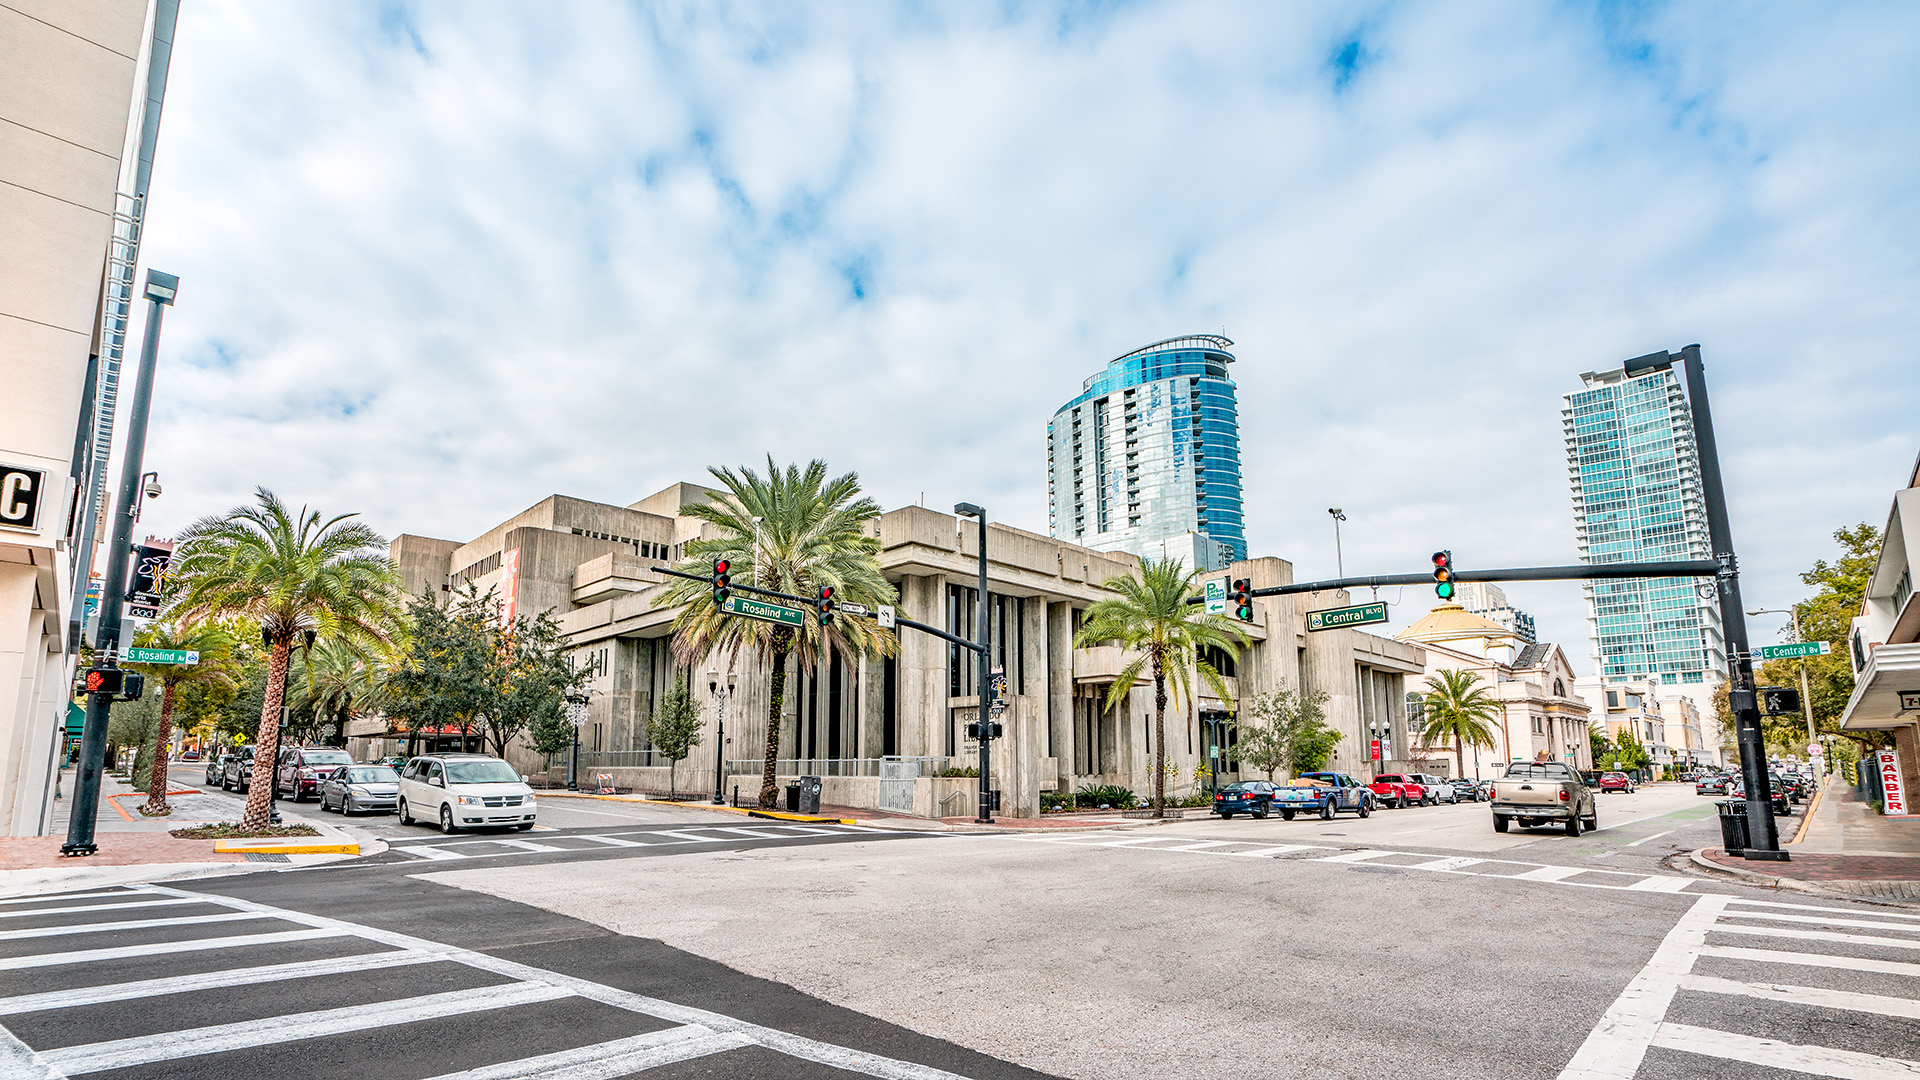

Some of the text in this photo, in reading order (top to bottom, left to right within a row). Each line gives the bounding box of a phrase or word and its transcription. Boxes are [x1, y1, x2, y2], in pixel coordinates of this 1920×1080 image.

[0, 472, 31, 520] C
[742, 601, 781, 618] Rosalind
[1325, 607, 1382, 624] Central BLVD
[129, 649, 135, 659] S
[138, 650, 175, 661] Rosalind
[1764, 648, 1770, 658] E
[1773, 645, 1806, 657] Central
[963, 712, 1000, 721] ORLDO
[1880, 755, 1902, 810] BARBER
